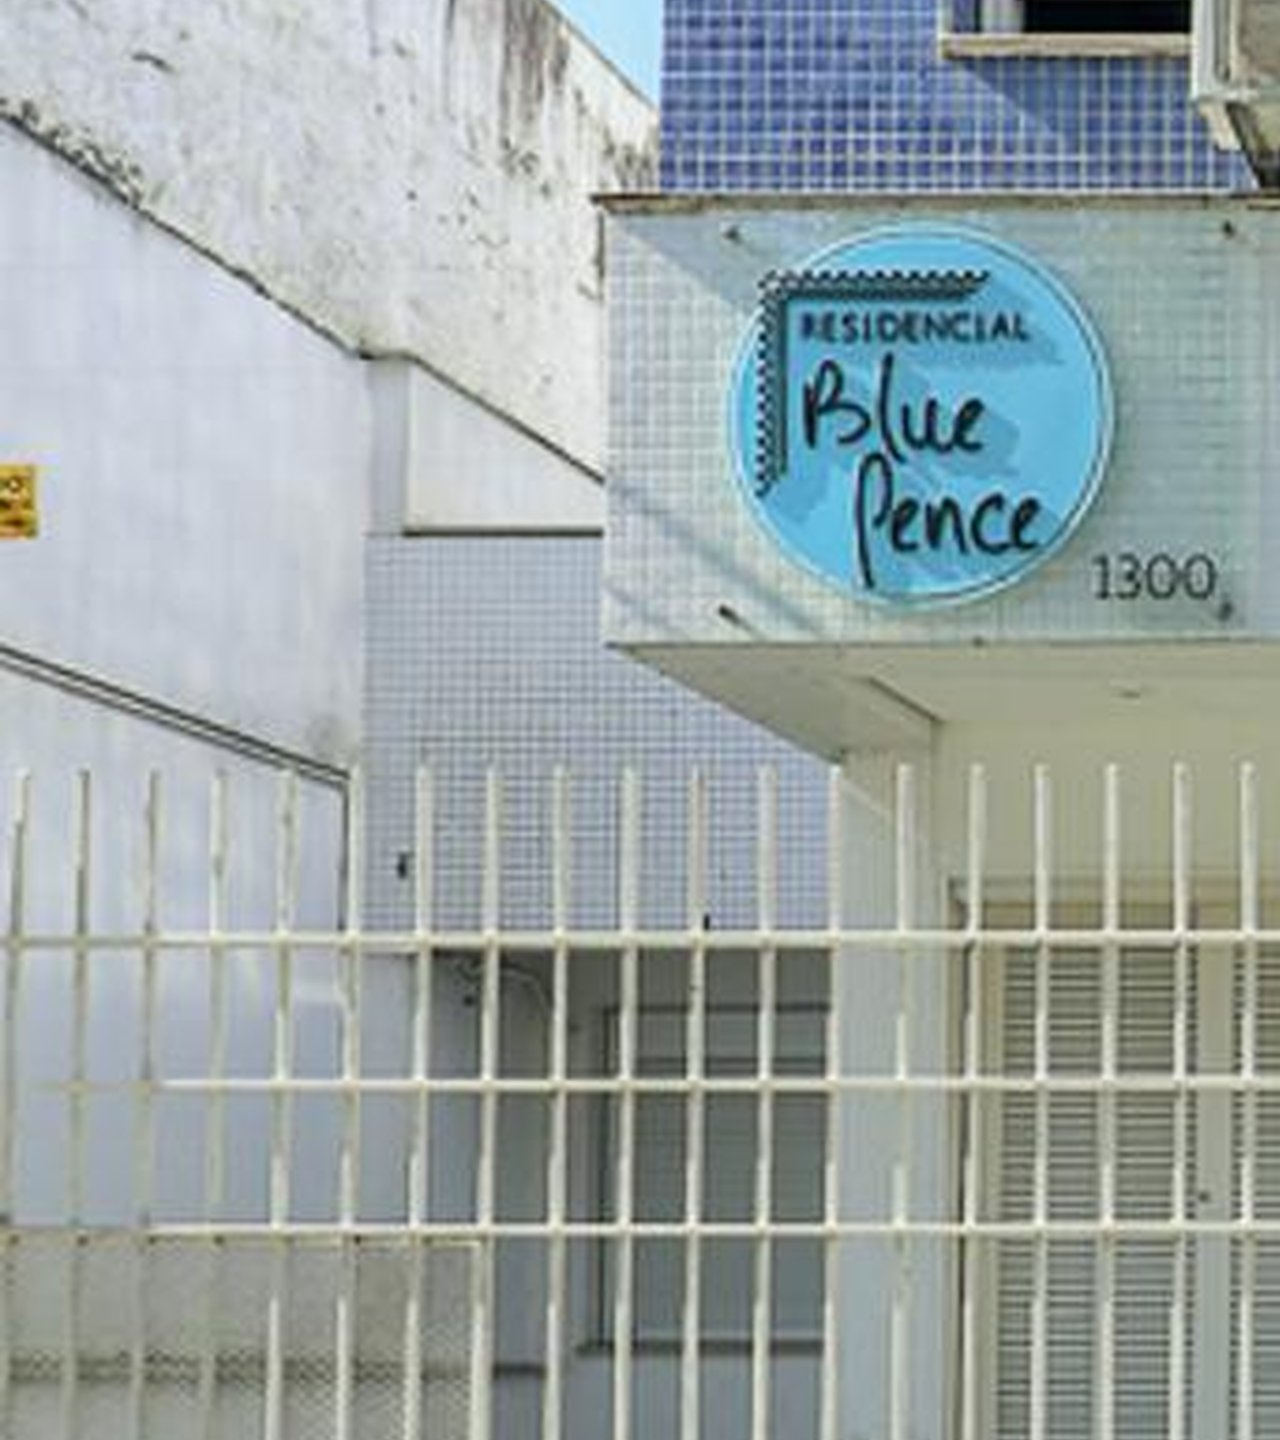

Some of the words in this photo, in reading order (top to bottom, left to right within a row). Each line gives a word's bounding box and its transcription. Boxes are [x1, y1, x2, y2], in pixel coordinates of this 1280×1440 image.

[800, 311, 1030, 344] RESIDENCIAL
[803, 352, 986, 463] Blue
[854, 451, 1041, 589] Pence
[1093, 553, 1218, 600] 1300
